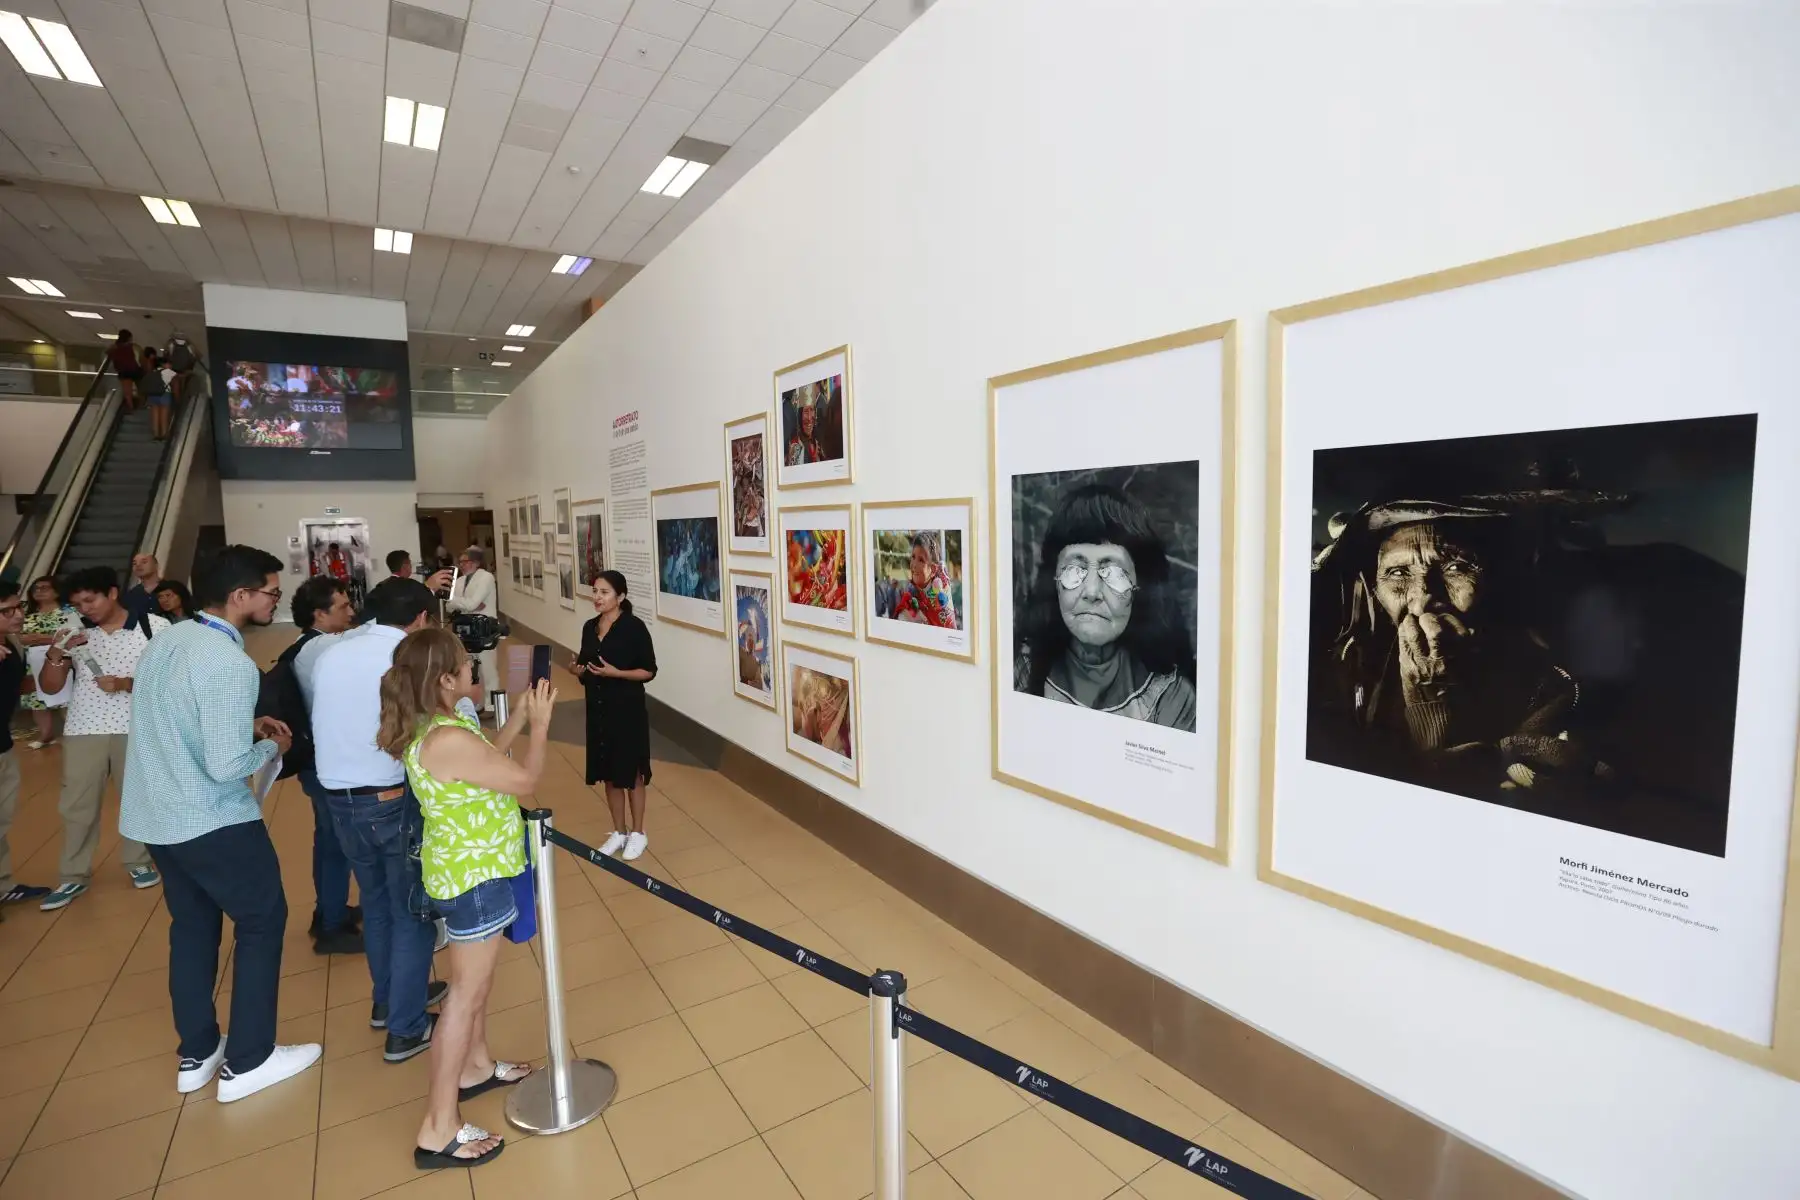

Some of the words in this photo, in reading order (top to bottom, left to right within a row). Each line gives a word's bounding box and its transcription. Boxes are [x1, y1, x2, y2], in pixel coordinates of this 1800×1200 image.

[293, 403, 342, 413] 11:43:21
[1559, 856, 1588, 871] Morfi
[1590, 865, 1634, 883] Jiménez
[1636, 877, 1689, 898] Mercado
[721, 915, 732, 924] LAP
[806, 955, 817, 965] LAP
[899, 1011, 913, 1022] LAP
[1032, 1075, 1049, 1088] LAP
[1206, 1158, 1229, 1175] LAP
